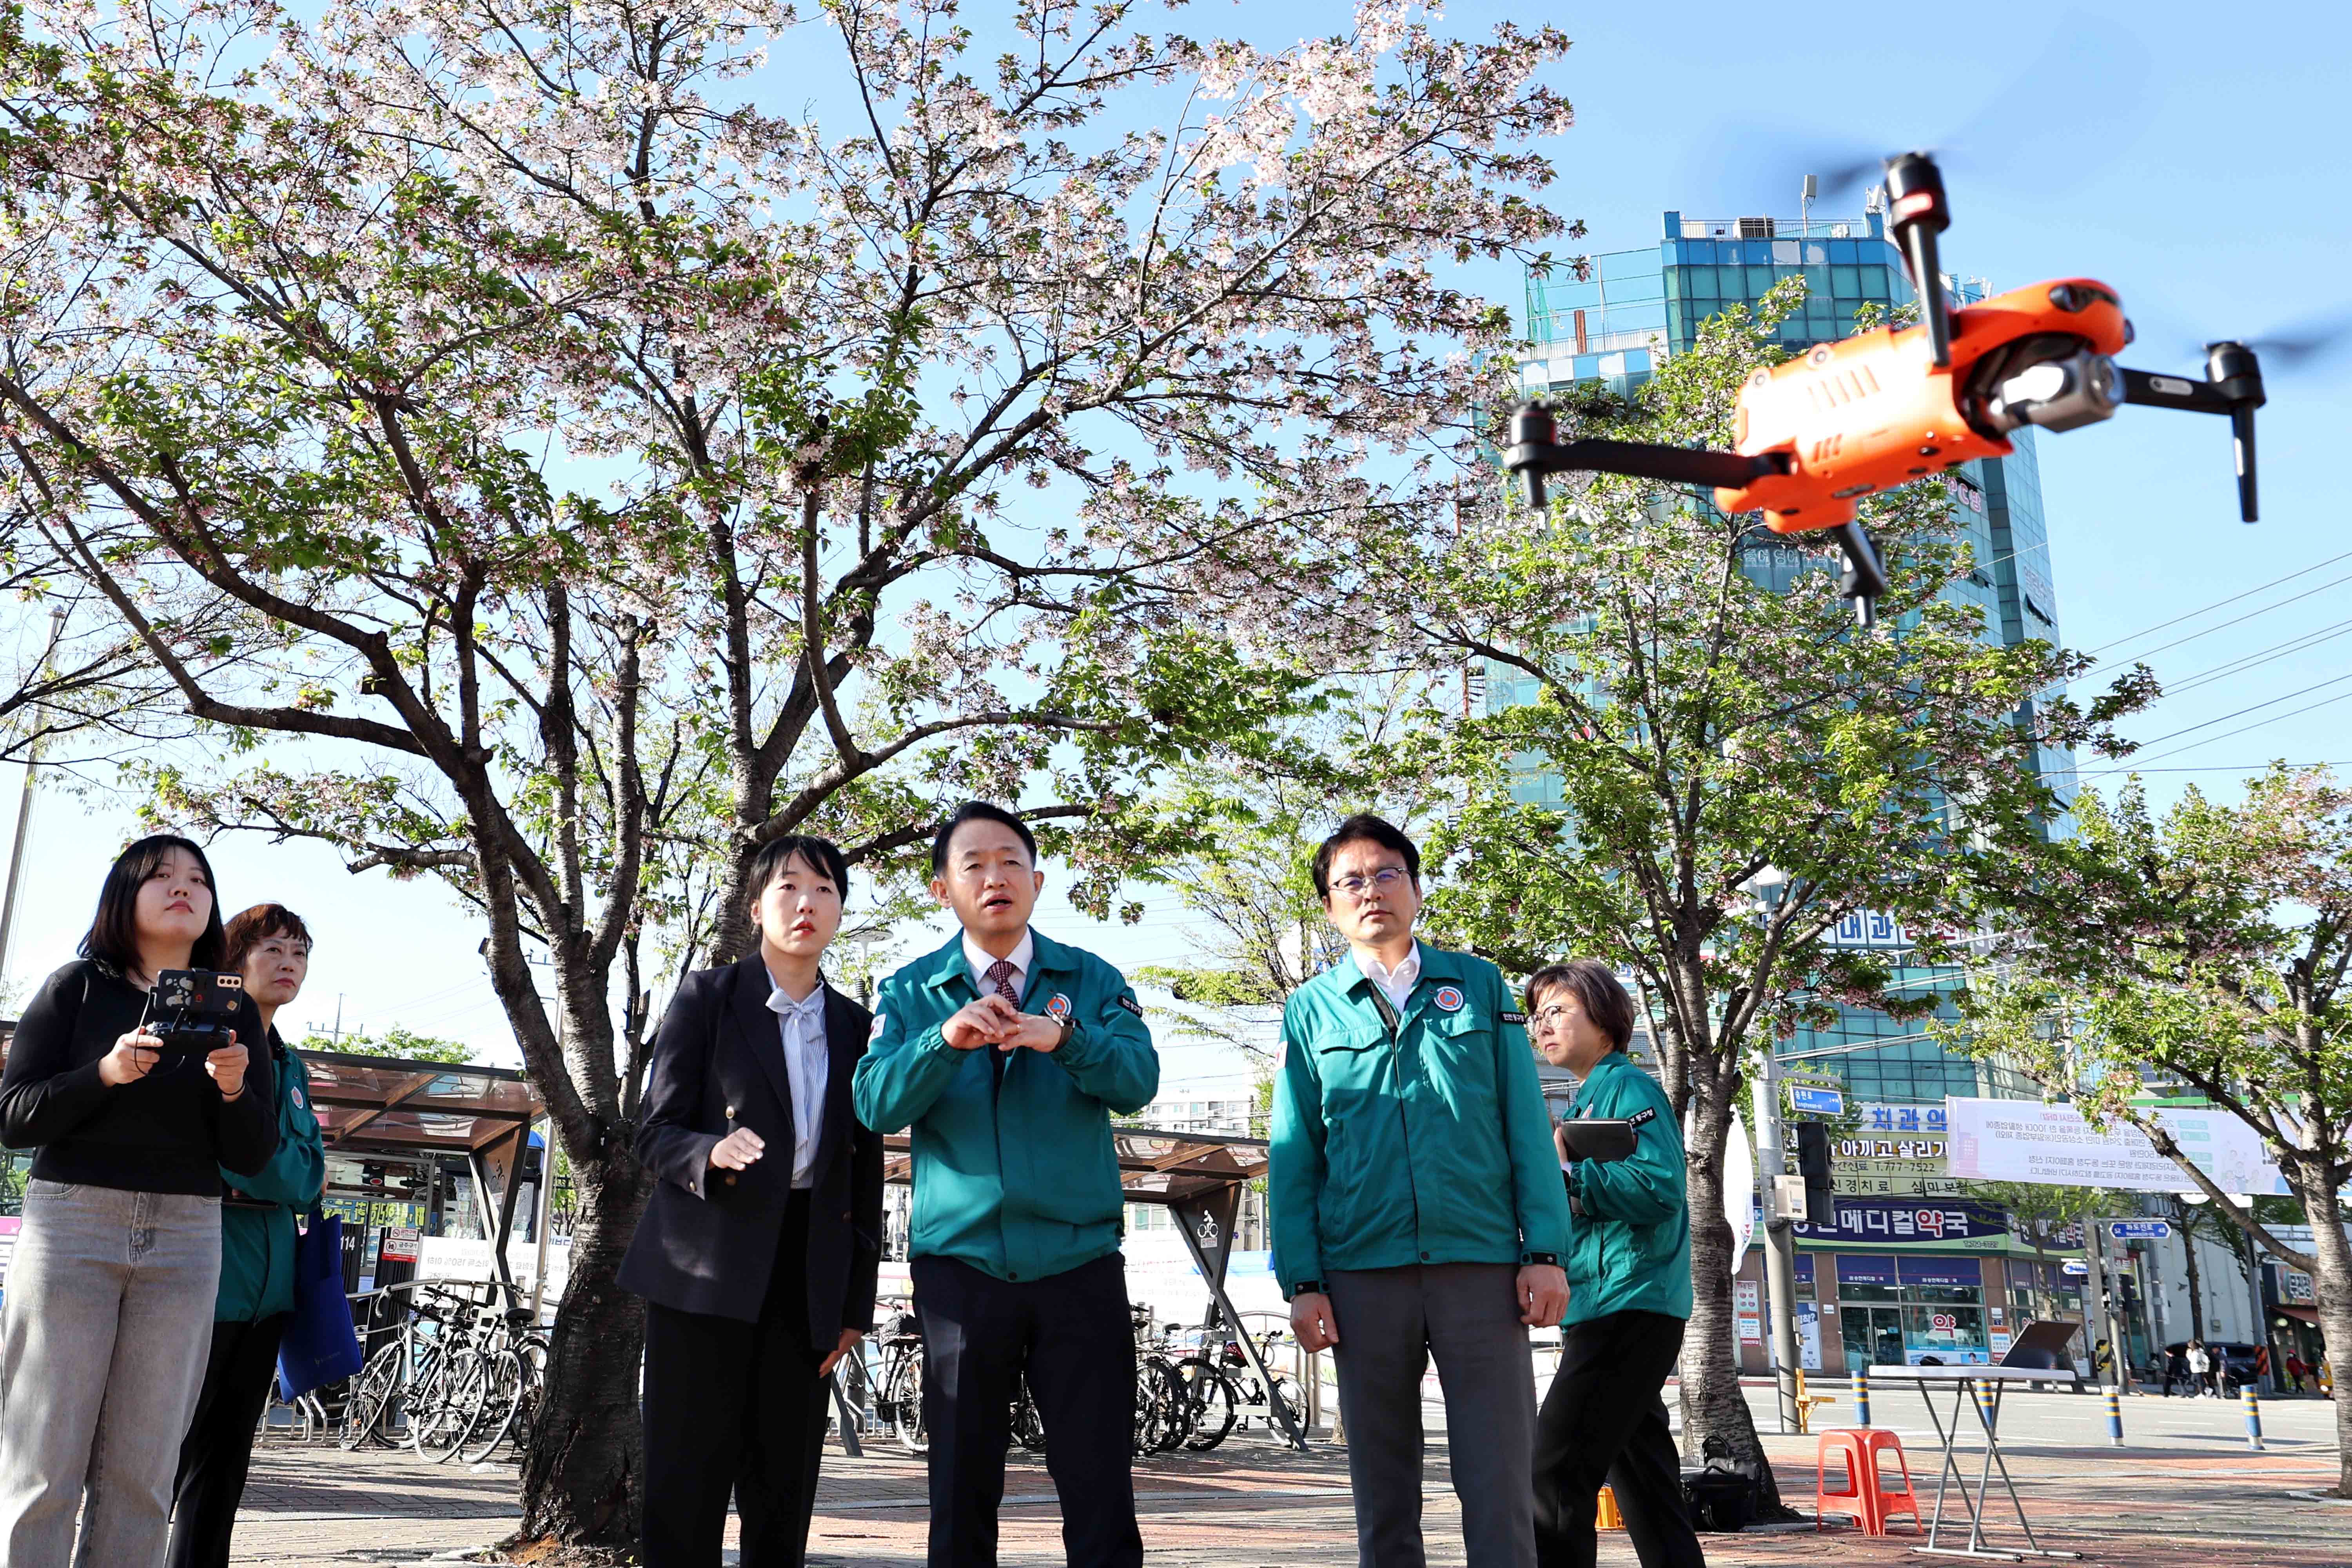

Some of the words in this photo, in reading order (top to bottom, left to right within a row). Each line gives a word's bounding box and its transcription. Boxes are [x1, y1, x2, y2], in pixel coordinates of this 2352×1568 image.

[1795, 1090, 1813, 1100] 송현로
[1635, 1108, 1653, 1122] 동구청
[1841, 1139, 1893, 1158] 아끼고
[1875, 1162, 1935, 1172] T.777-7522
[1933, 1314, 1956, 1339] 약
